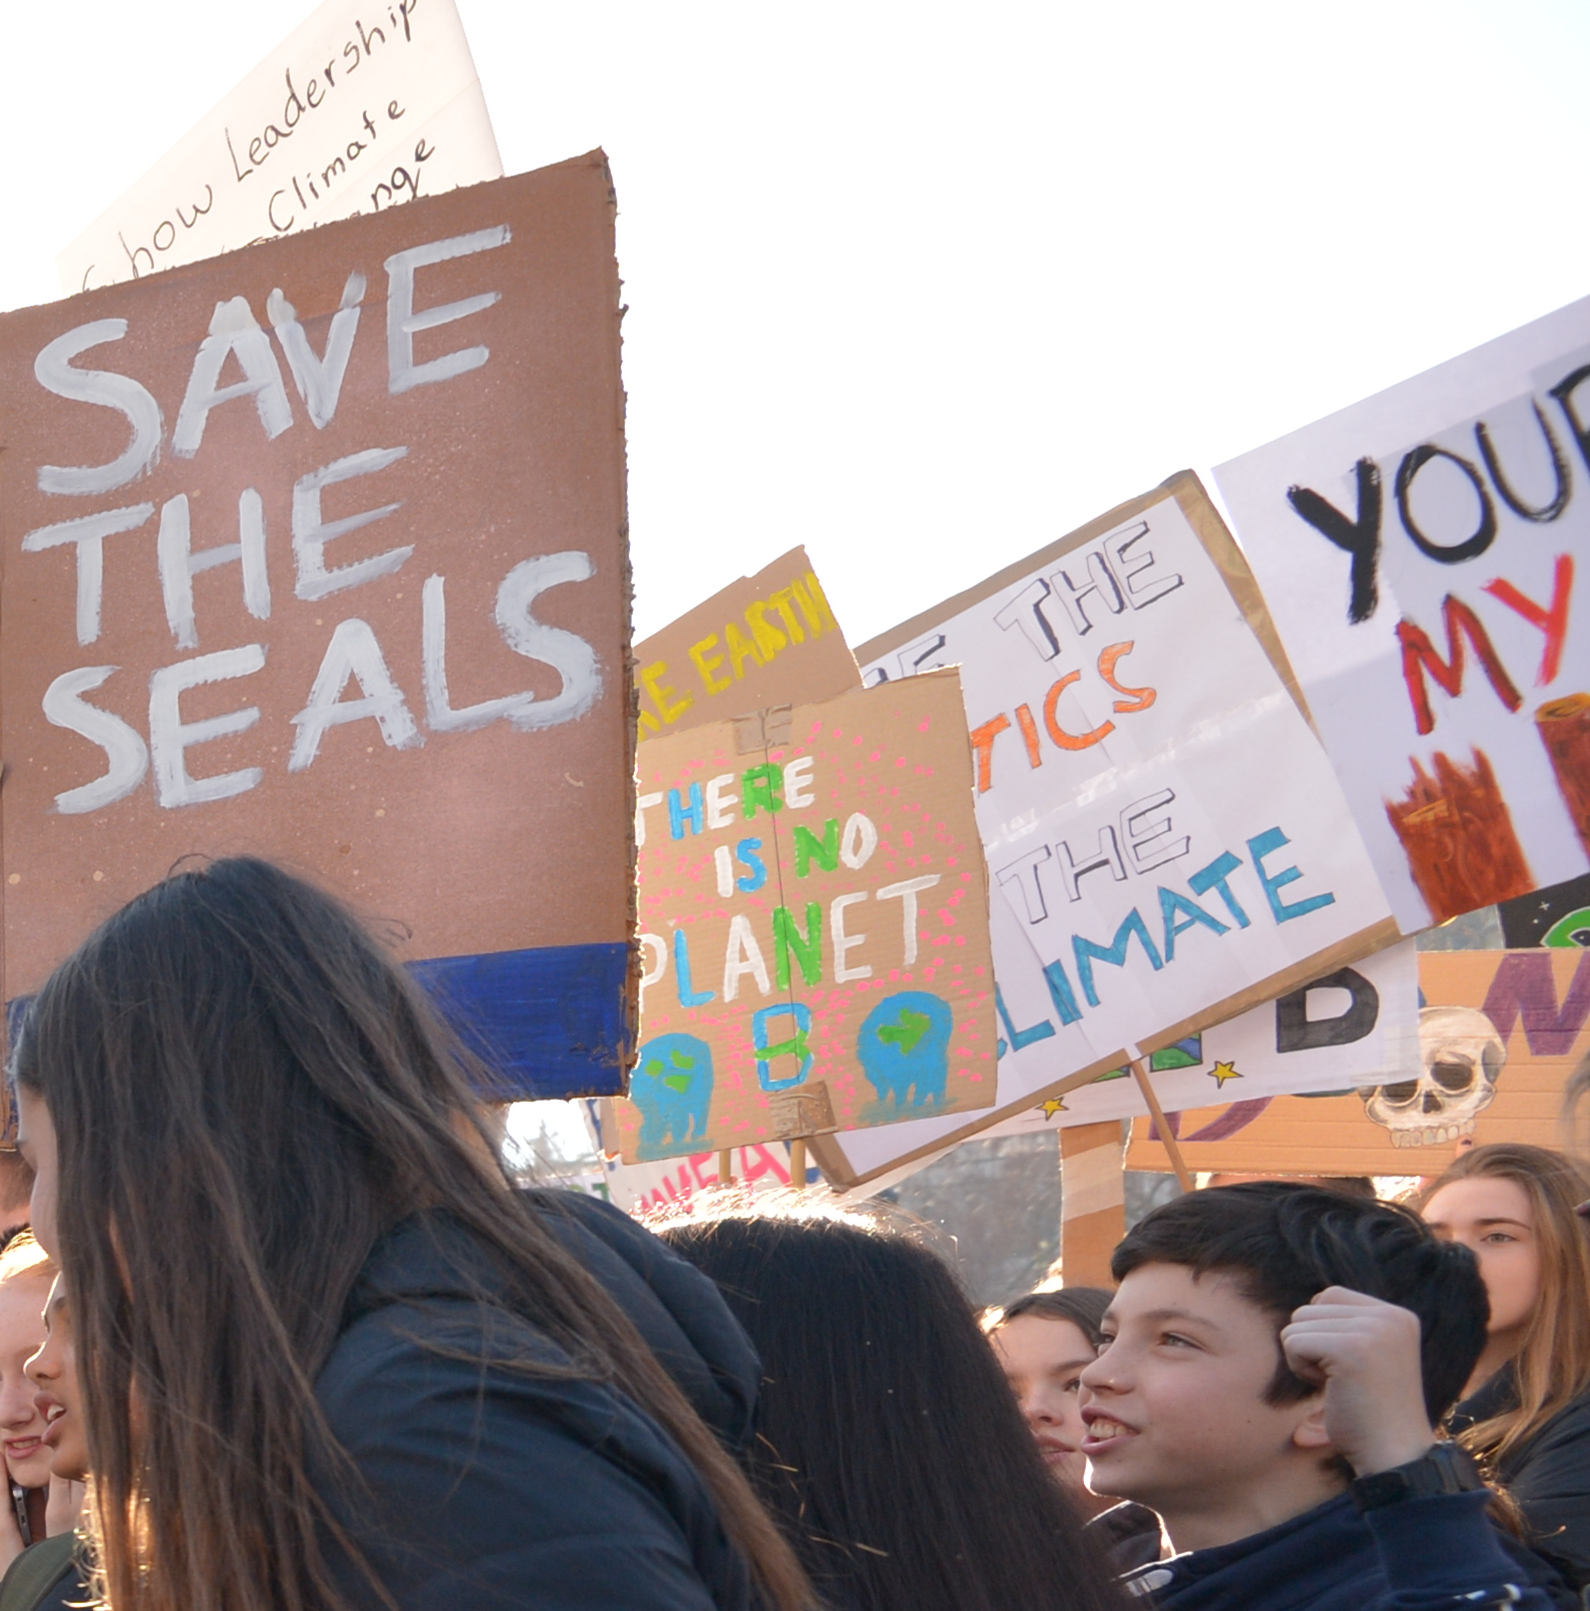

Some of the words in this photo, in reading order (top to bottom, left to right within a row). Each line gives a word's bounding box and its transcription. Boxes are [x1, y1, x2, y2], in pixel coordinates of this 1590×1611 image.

[268, 100, 406, 232] Climate
[82, 184, 213, 291] how
[34, 223, 512, 496] SAVE
[22, 445, 416, 650] THE
[993, 520, 1184, 661] THE
[41, 550, 605, 816] SEALS
[688, 570, 839, 700] EARTH
[1394, 553, 1576, 735] MY
[971, 640, 1157, 793] TICS
[635, 756, 815, 846] THERE
[714, 838, 767, 898] IS
[794, 811, 879, 879] NO
[994, 788, 1191, 925] THE
[637, 873, 942, 1009] PLANET
[994, 826, 1336, 1057] LIMATE
[751, 1001, 814, 1092] B
